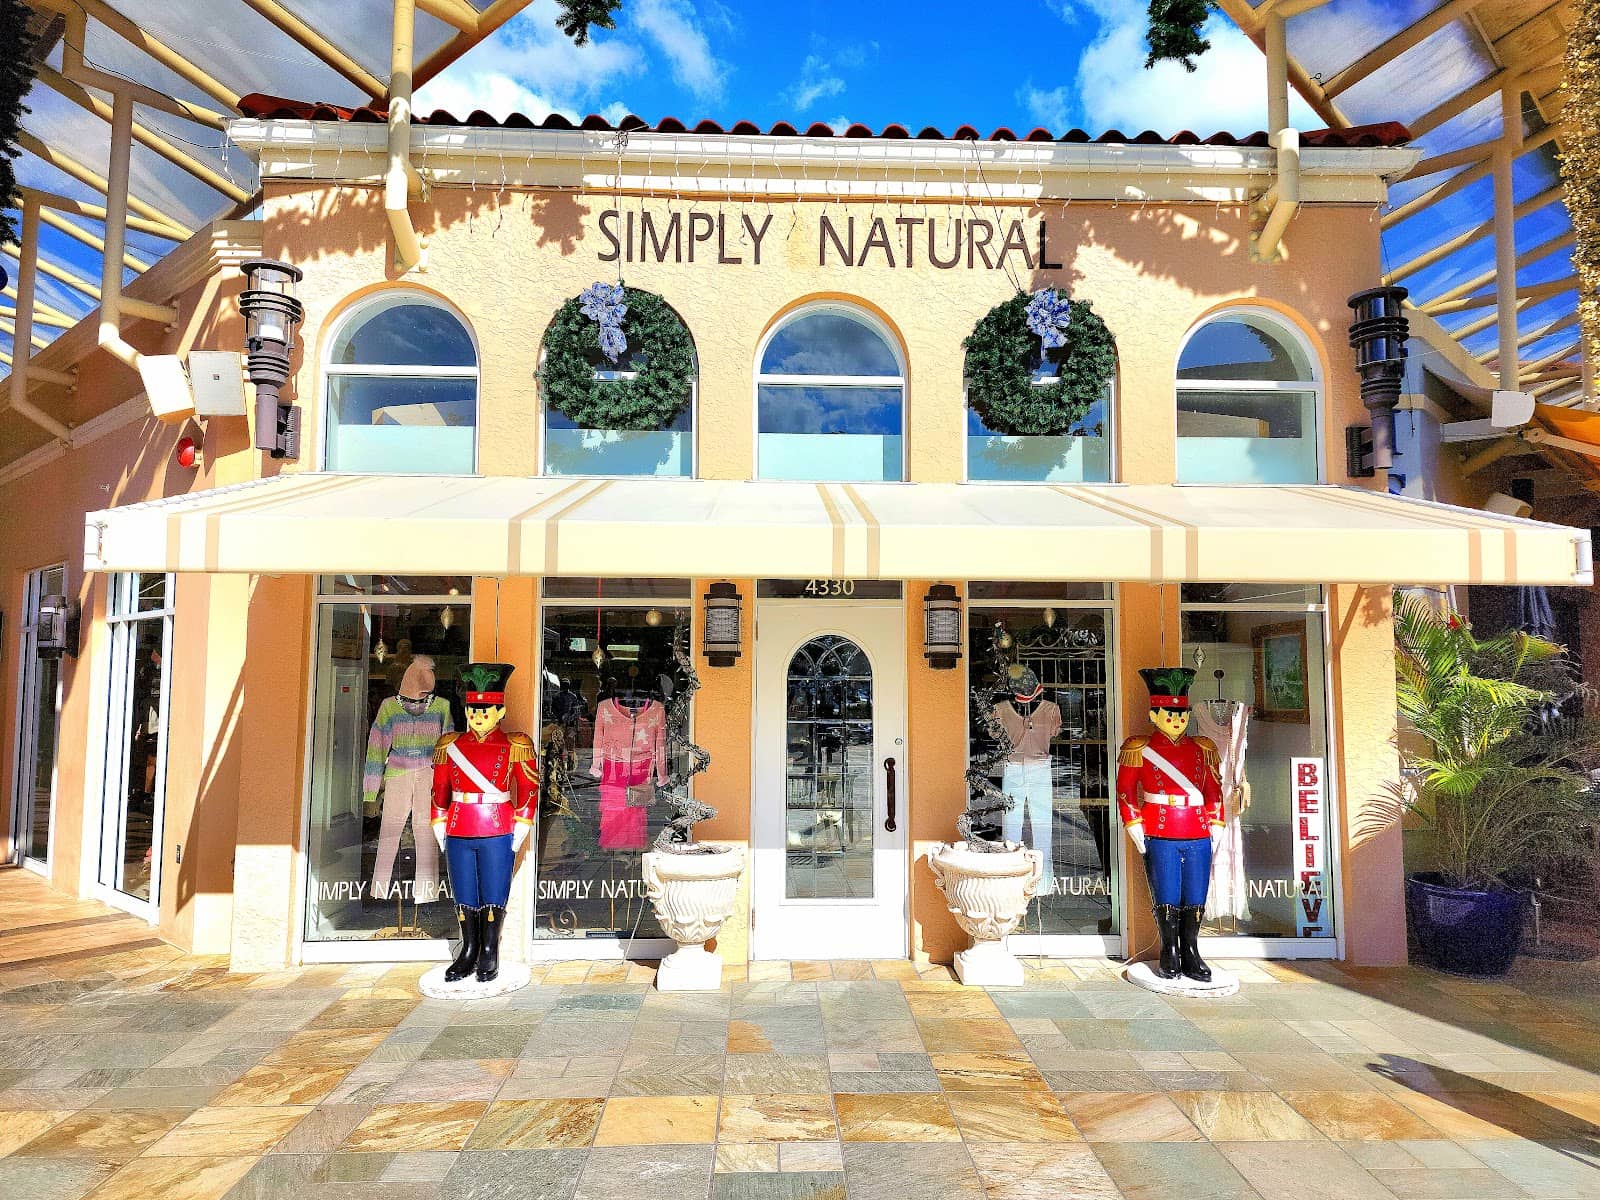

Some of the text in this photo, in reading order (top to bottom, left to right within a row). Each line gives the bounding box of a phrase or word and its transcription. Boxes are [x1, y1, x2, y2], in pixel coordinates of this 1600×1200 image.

[598, 209, 1063, 270] SIMPLY NATURAL
[805, 579, 855, 596] 4330
[315, 879, 455, 900] IMPLY NATURA
[538, 879, 649, 900] SIMPLY NATU
[1249, 879, 1329, 898] NATURAL
